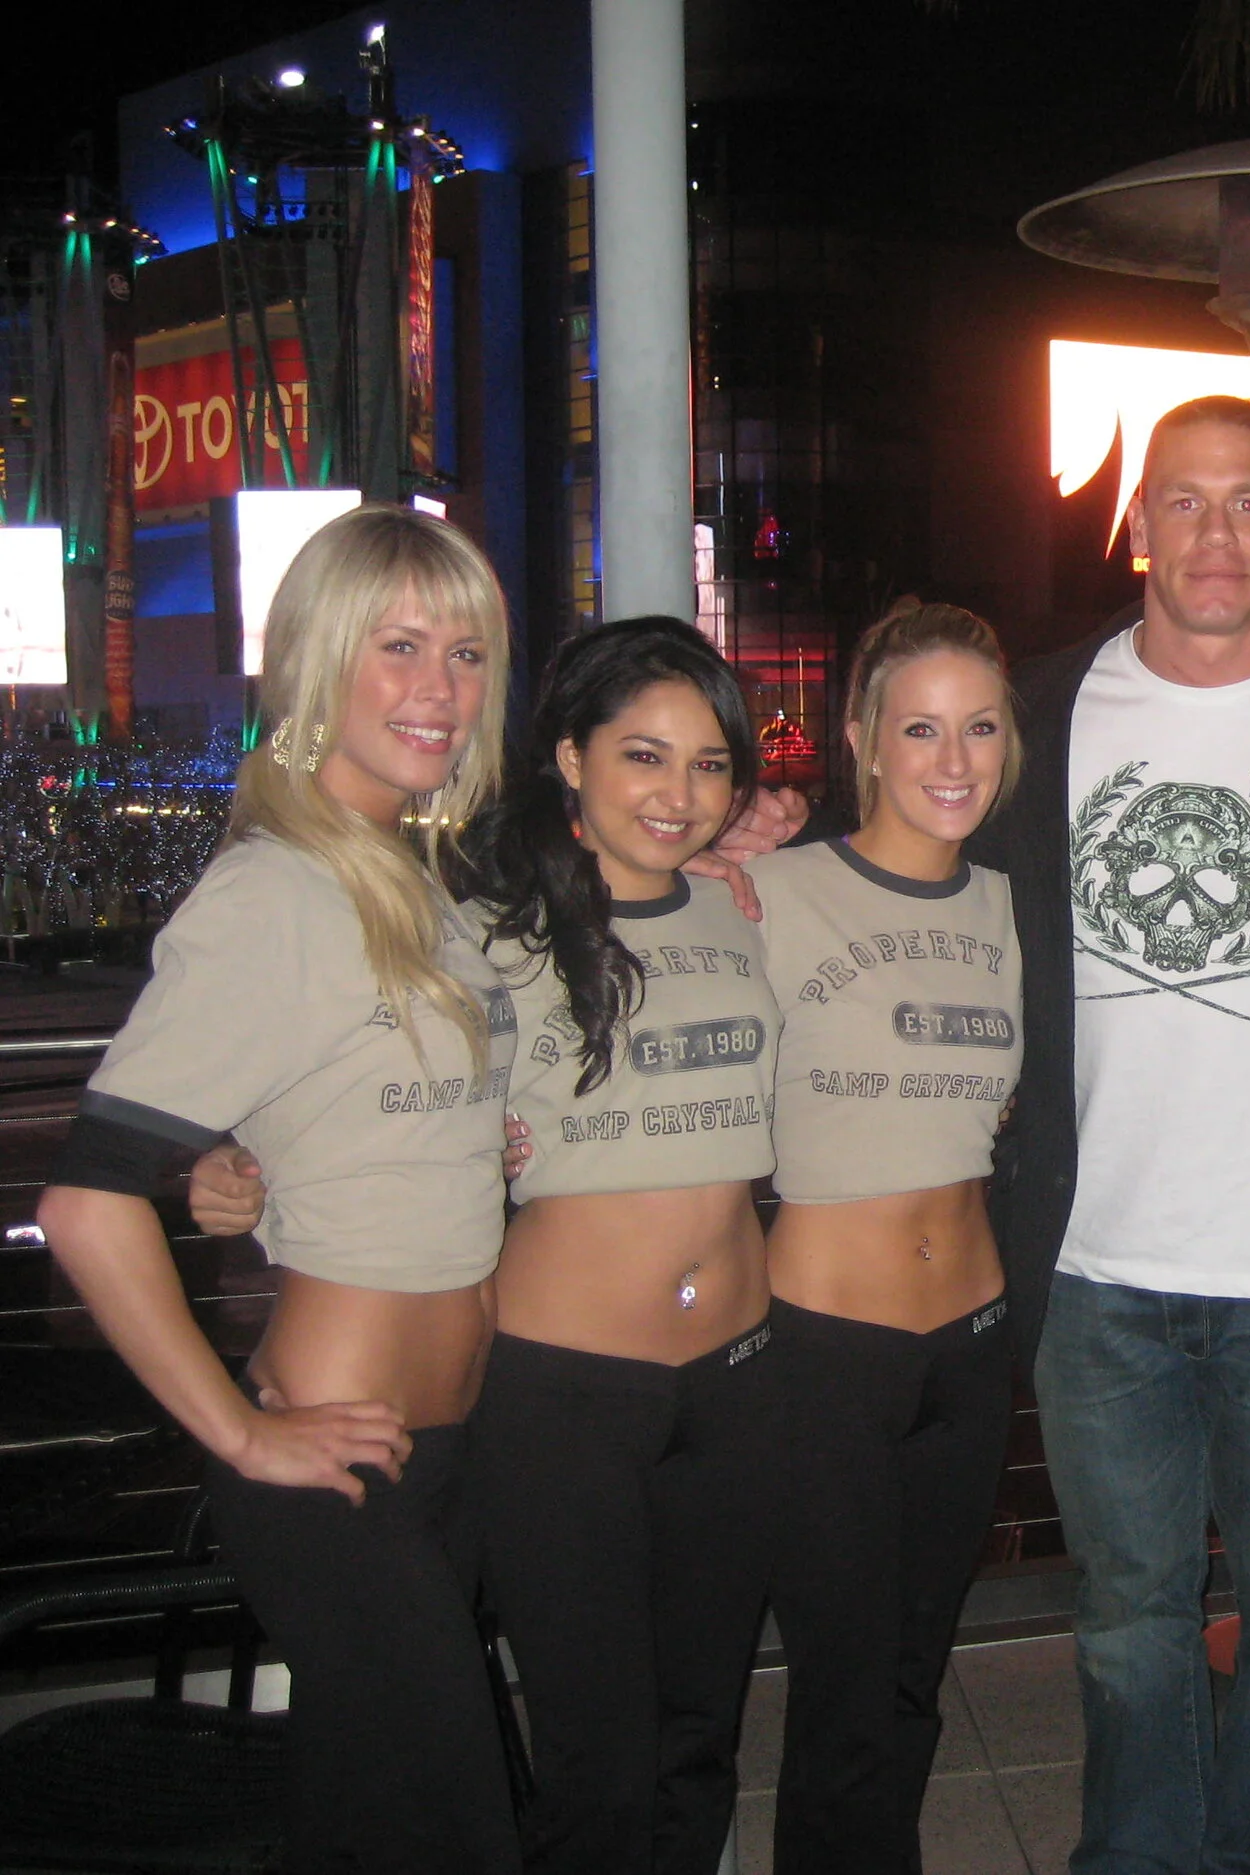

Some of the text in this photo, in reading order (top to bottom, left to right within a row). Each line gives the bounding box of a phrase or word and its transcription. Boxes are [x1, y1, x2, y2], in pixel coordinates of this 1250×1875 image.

[176, 379, 309, 463] TOOT
[799, 929, 1003, 1005] PROPERTY
[530, 945, 751, 1067] PRERTY
[904, 1012, 1009, 1039] EST. 1980
[641, 1030, 757, 1065] EST. 1980
[381, 1078, 465, 1113] CAMP
[809, 1069, 1006, 1102] CAMP CRYSTAL
[642, 1096, 760, 1136] CRYSTAL
